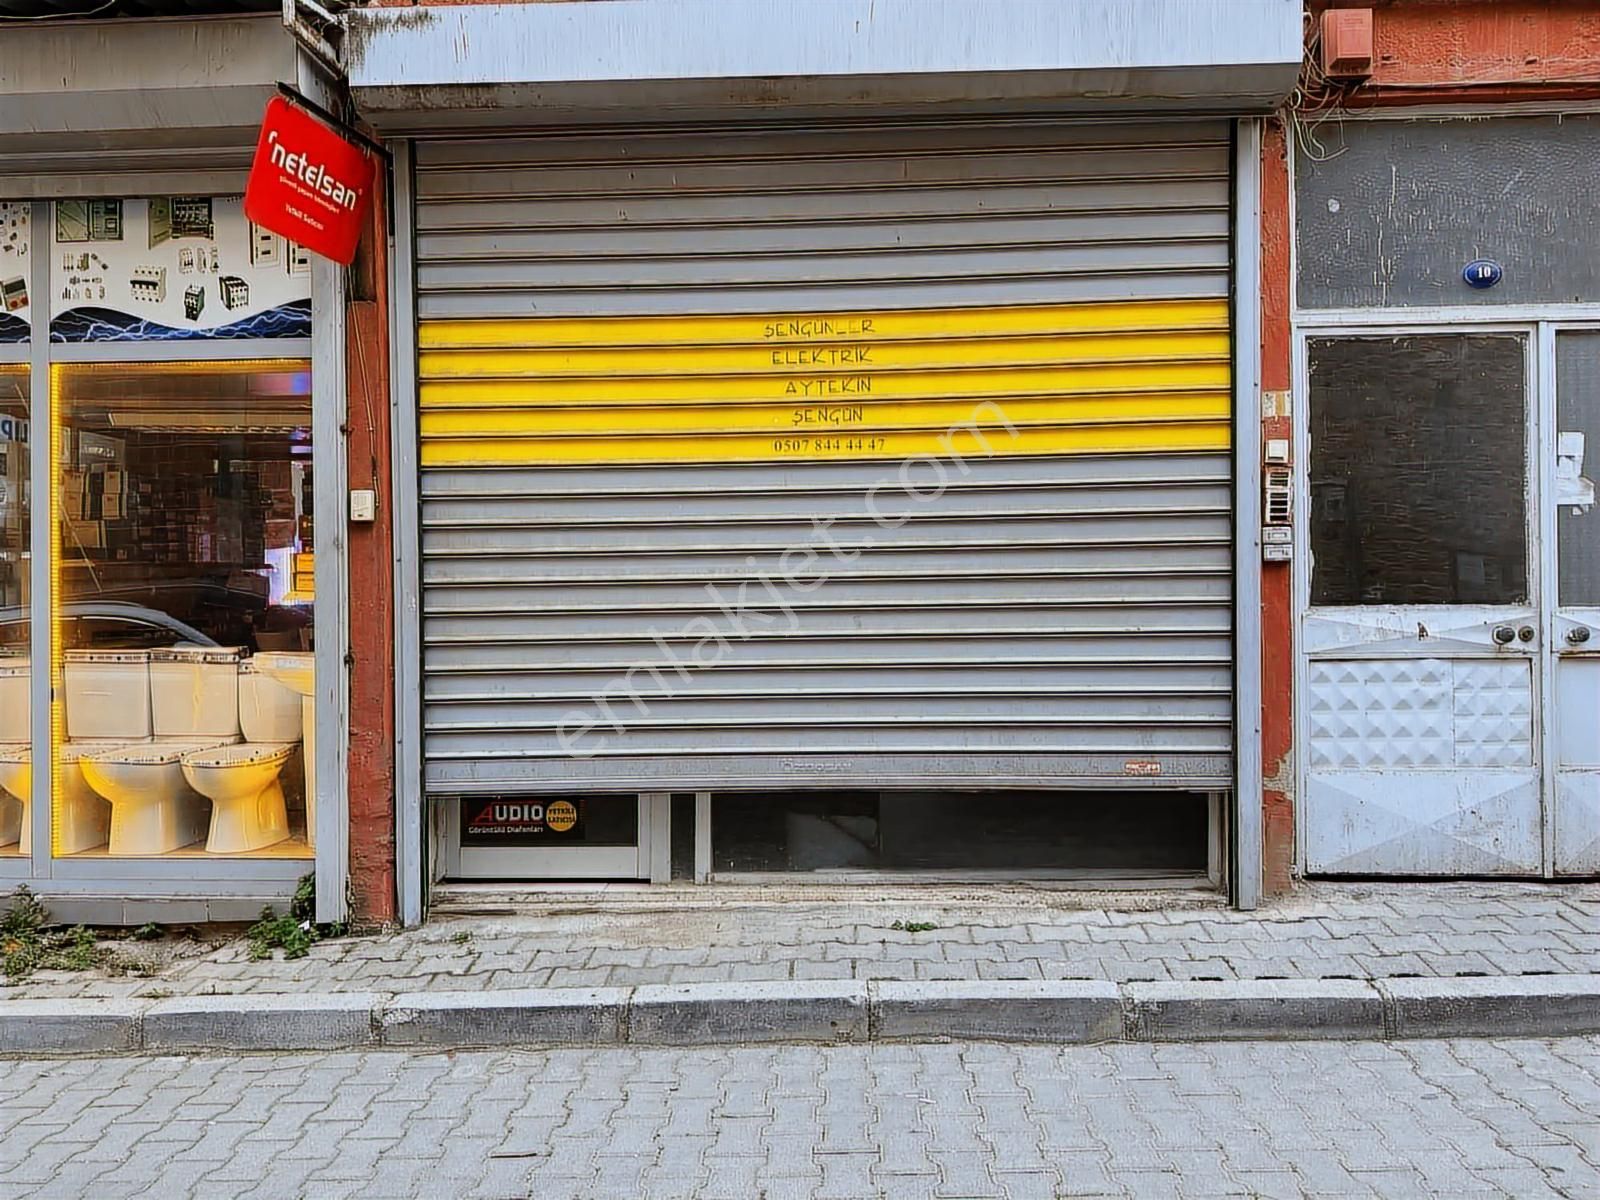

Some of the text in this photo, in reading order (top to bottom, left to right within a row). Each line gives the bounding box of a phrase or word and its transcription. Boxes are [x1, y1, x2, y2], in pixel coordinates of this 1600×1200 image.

[269, 131, 356, 211] netelsan
[1478, 266, 1490, 278] 10
[774, 438, 886, 452] 0507 844 44 47
[474, 804, 544, 822] AUDIO
